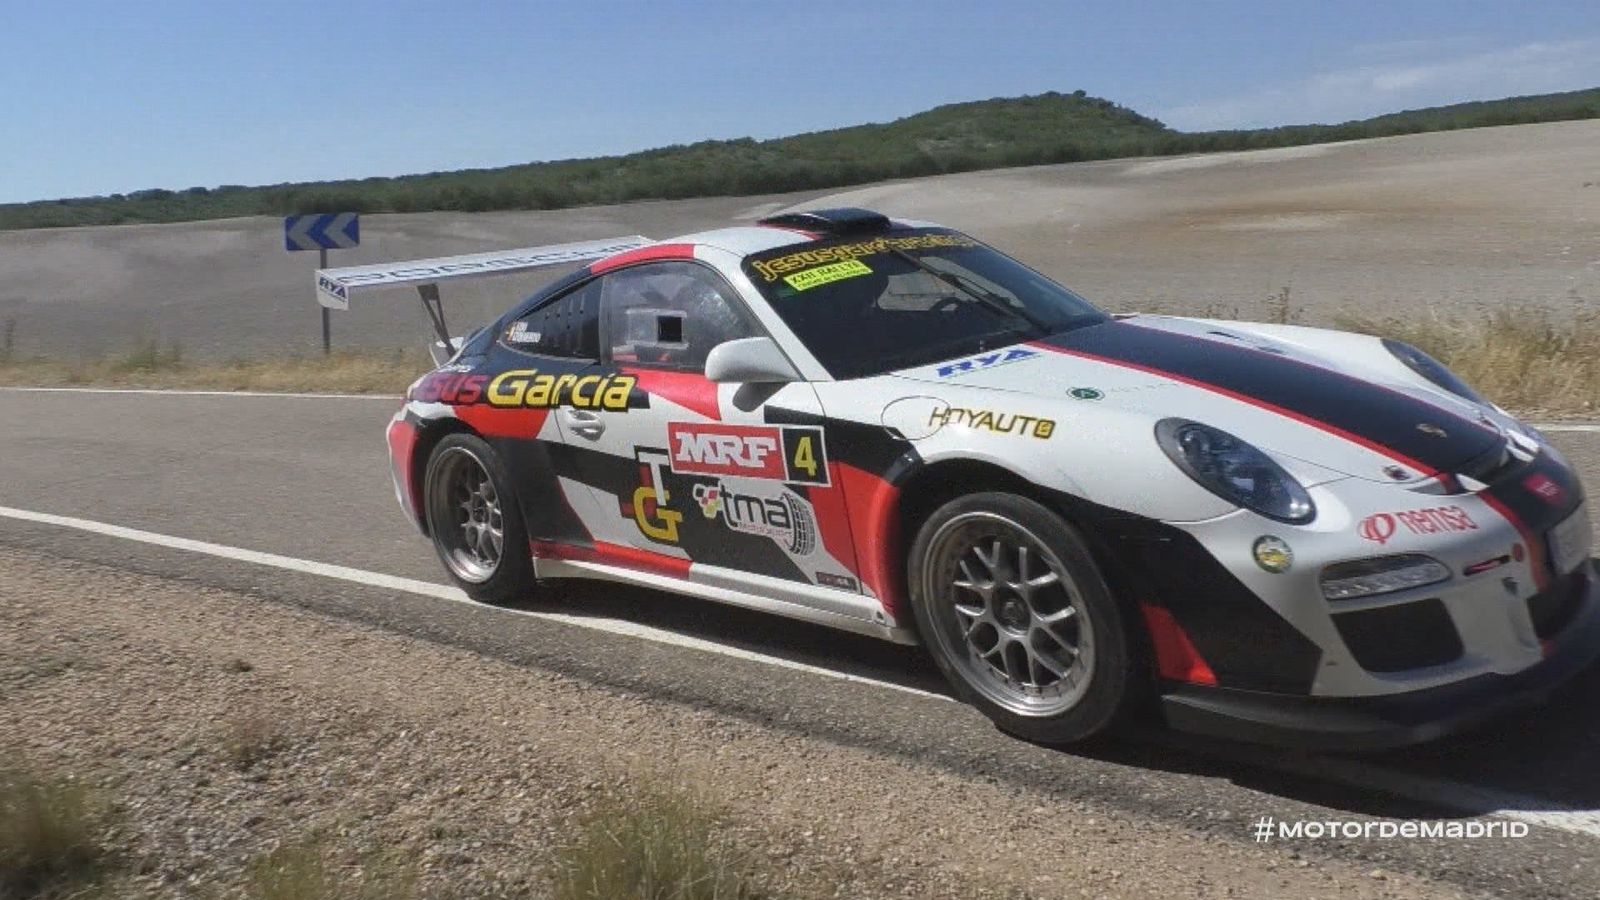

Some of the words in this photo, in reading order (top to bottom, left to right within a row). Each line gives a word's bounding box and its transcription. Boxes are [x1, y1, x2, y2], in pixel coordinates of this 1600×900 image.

[937, 349, 1038, 378] RYA
[675, 431, 777, 468] MRF
[794, 436, 817, 477] 4
[720, 484, 791, 529] tma
